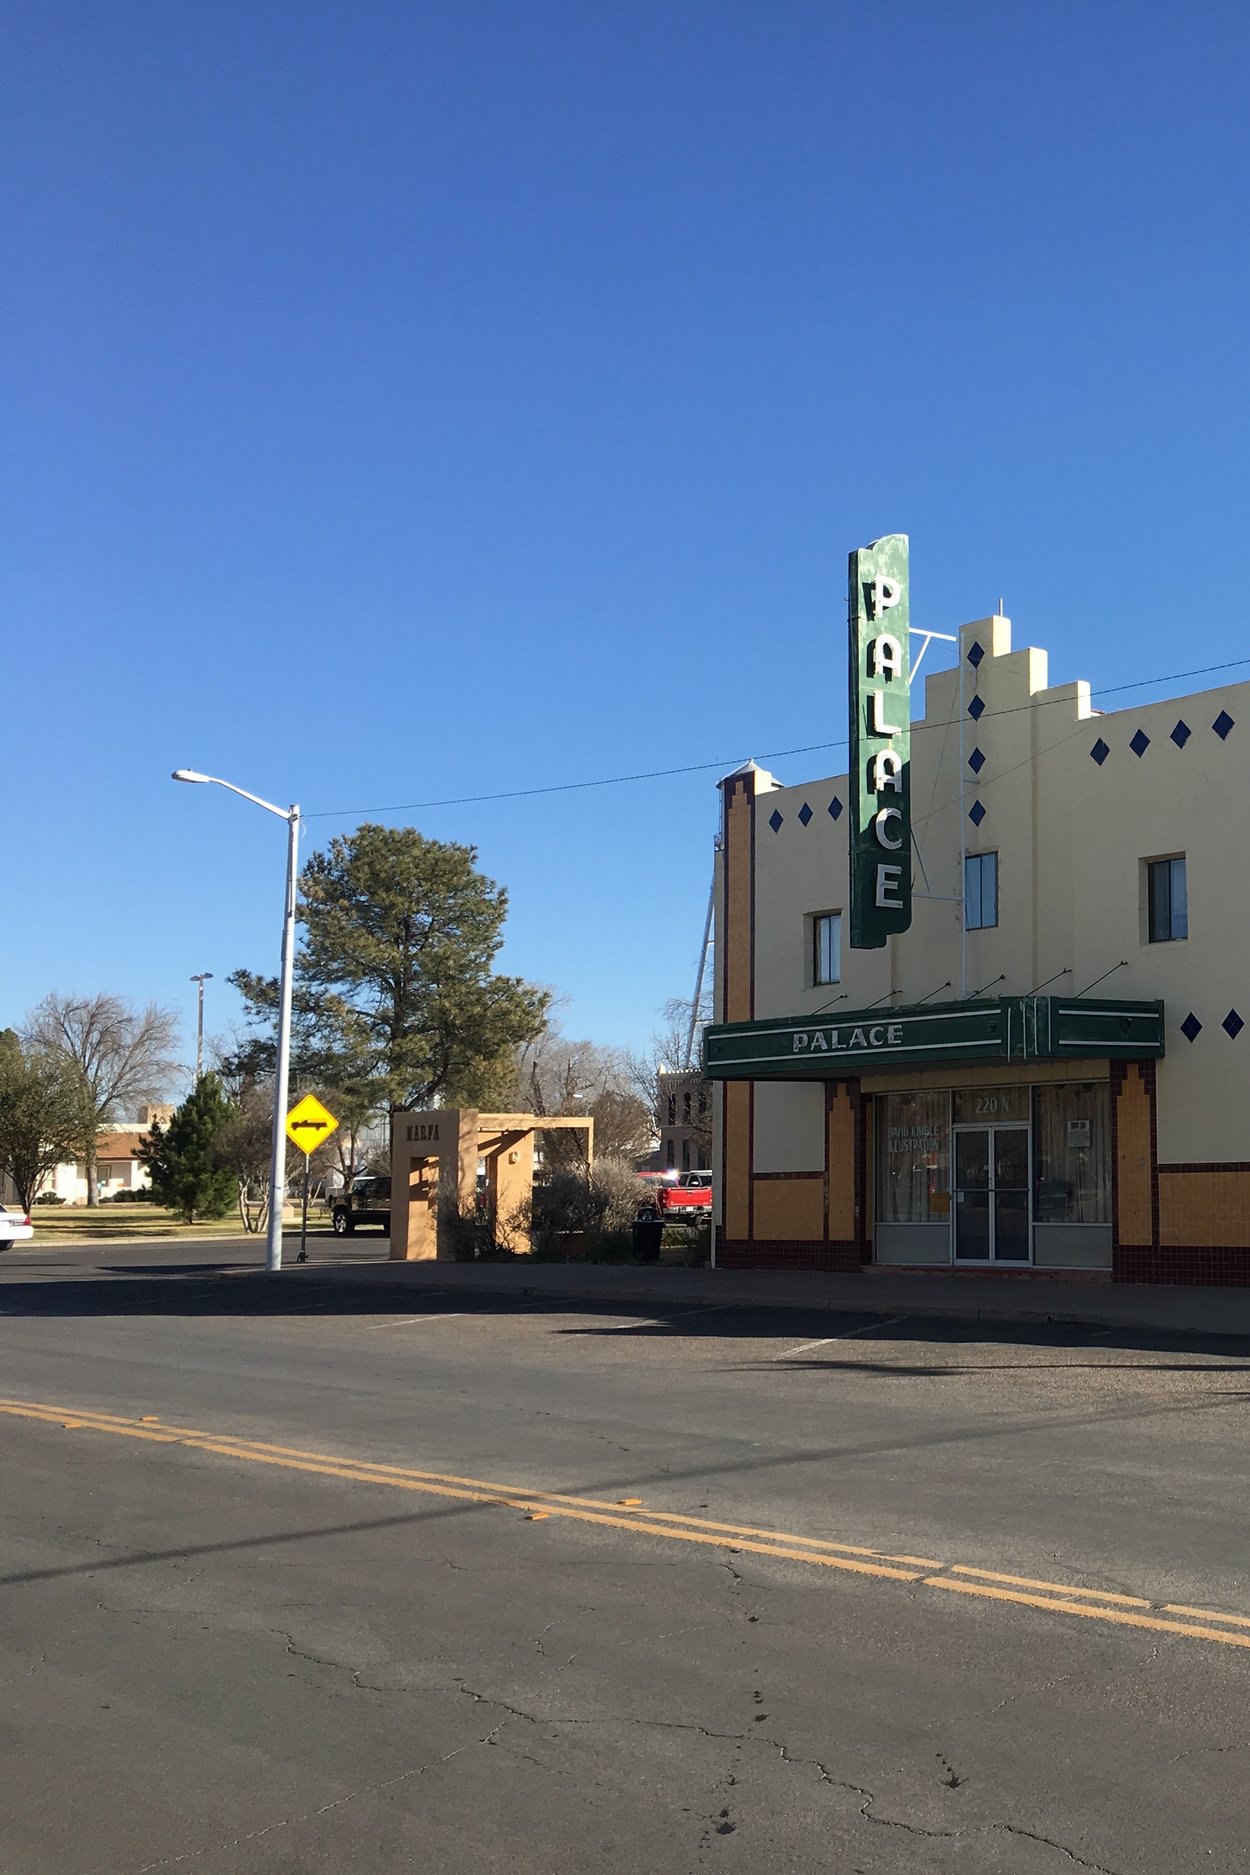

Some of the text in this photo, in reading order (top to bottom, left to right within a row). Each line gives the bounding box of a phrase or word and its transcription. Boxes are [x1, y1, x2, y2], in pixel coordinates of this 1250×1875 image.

[872, 574, 904, 910] PALACE
[793, 1025, 904, 1052] PALACE
[975, 1096, 1010, 1114] 220 N
[888, 1123, 940, 1138] DAVID KIMBLE
[888, 1138, 940, 1153] ILLUSTRATION
